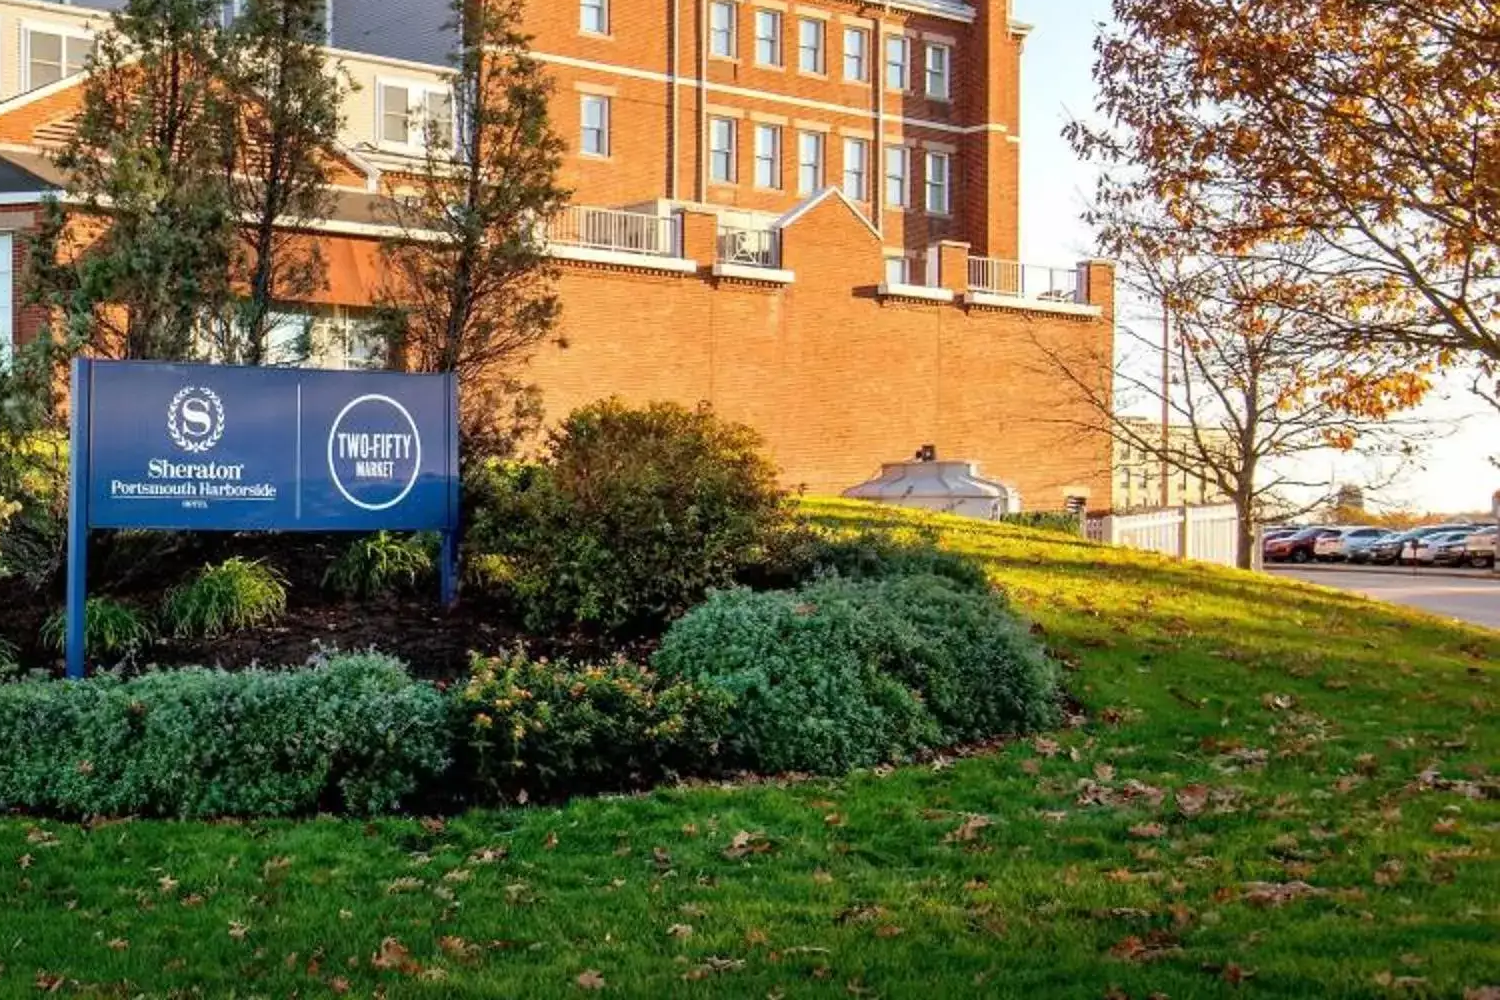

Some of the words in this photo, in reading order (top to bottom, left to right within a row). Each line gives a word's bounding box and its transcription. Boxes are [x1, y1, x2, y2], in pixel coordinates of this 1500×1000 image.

[182, 398, 211, 437] S
[338, 433, 412, 459] TWO-FIFTY
[148, 458, 243, 480] Sheraton
[356, 461, 395, 478] MARKET
[111, 480, 197, 496] Portsmouth
[200, 482, 277, 498] Harborside
